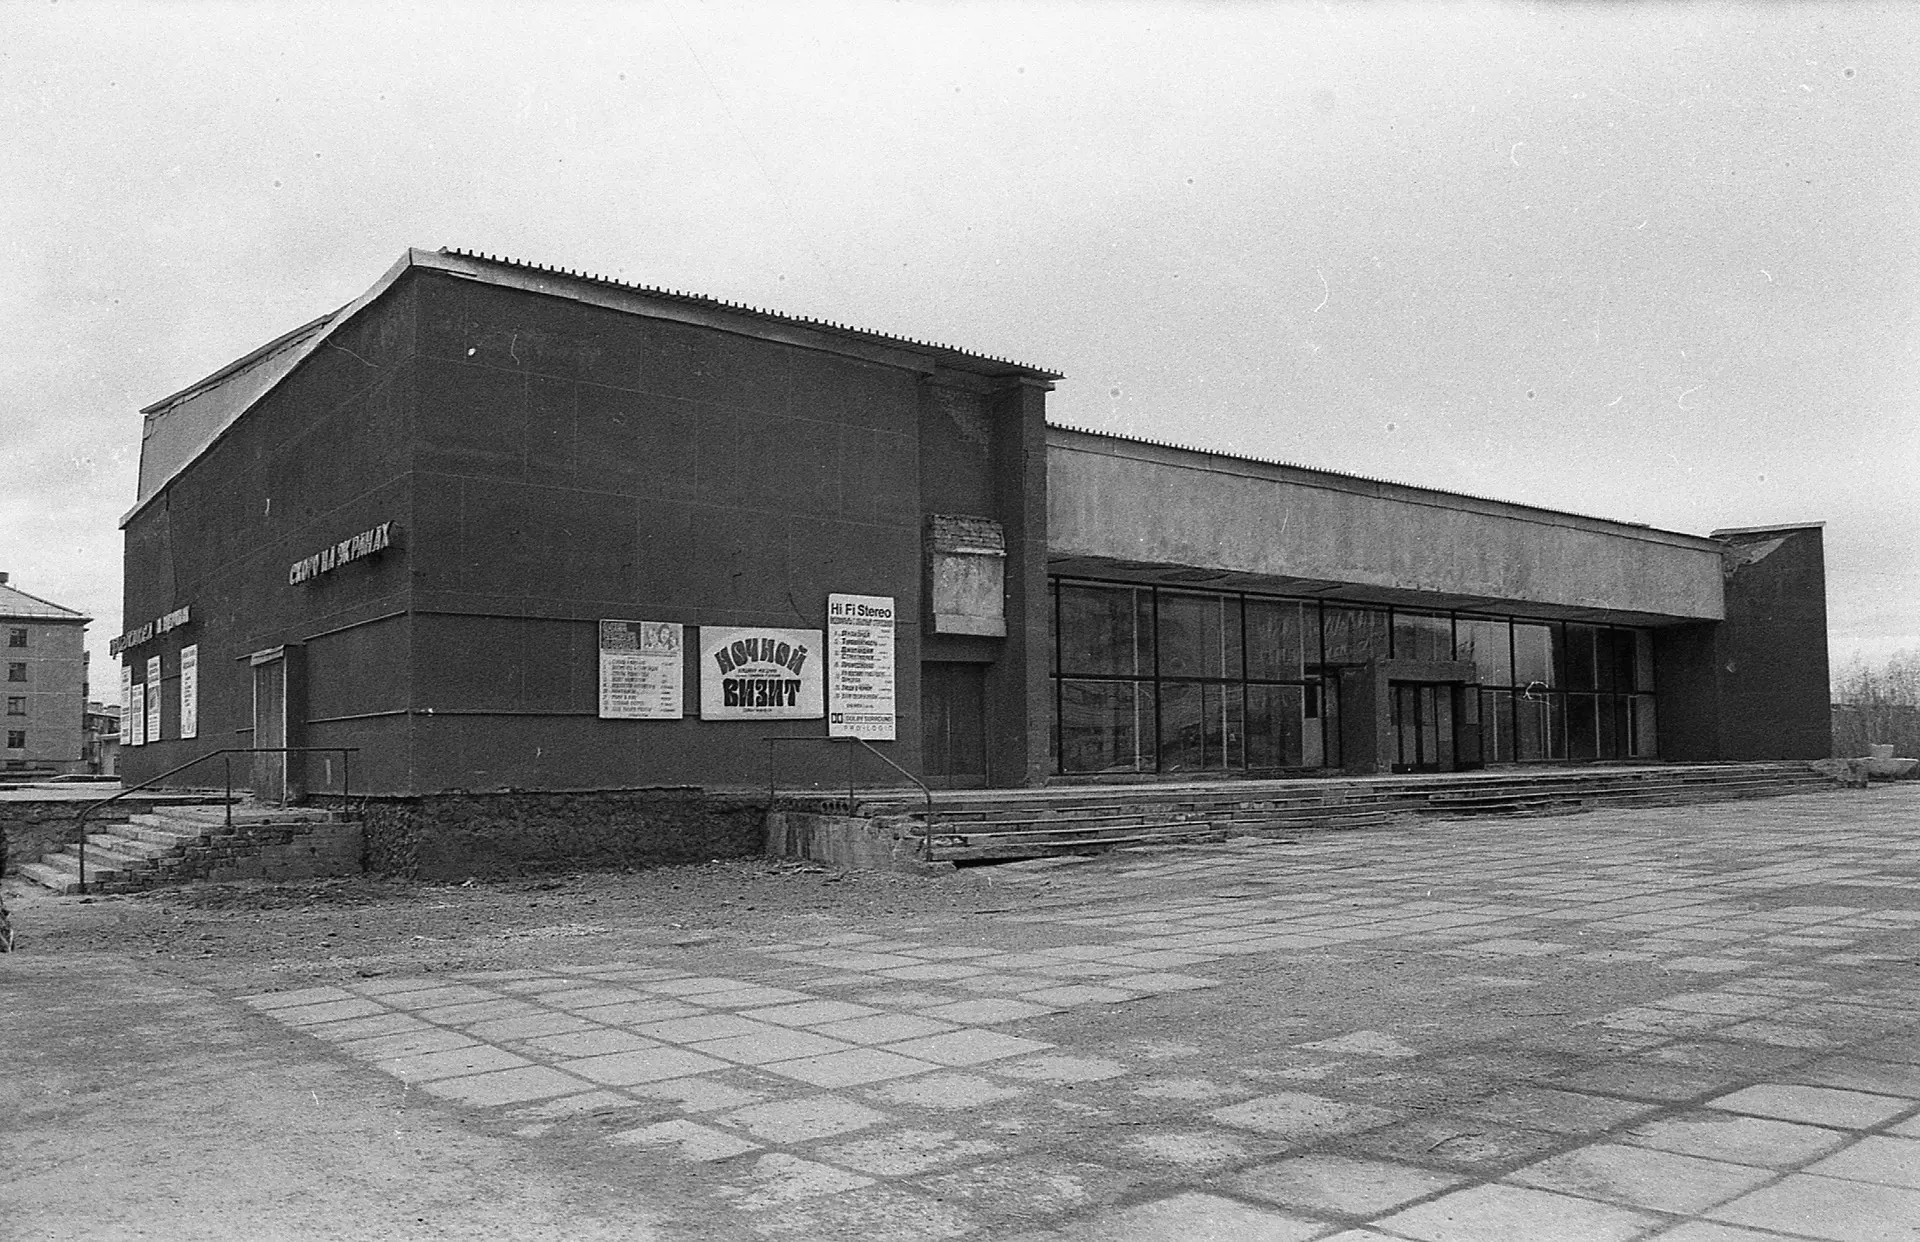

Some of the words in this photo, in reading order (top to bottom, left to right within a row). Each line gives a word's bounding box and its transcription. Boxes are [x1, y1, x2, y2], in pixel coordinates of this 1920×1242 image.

[337, 521, 391, 566] ЭКРАНАХ
[831, 603, 842, 615] Hi
[845, 603, 855, 615] Fi
[857, 604, 892, 618] Stereo
[714, 637, 808, 676] НОЧНОЙ
[722, 678, 802, 707] ВИЗИТ
